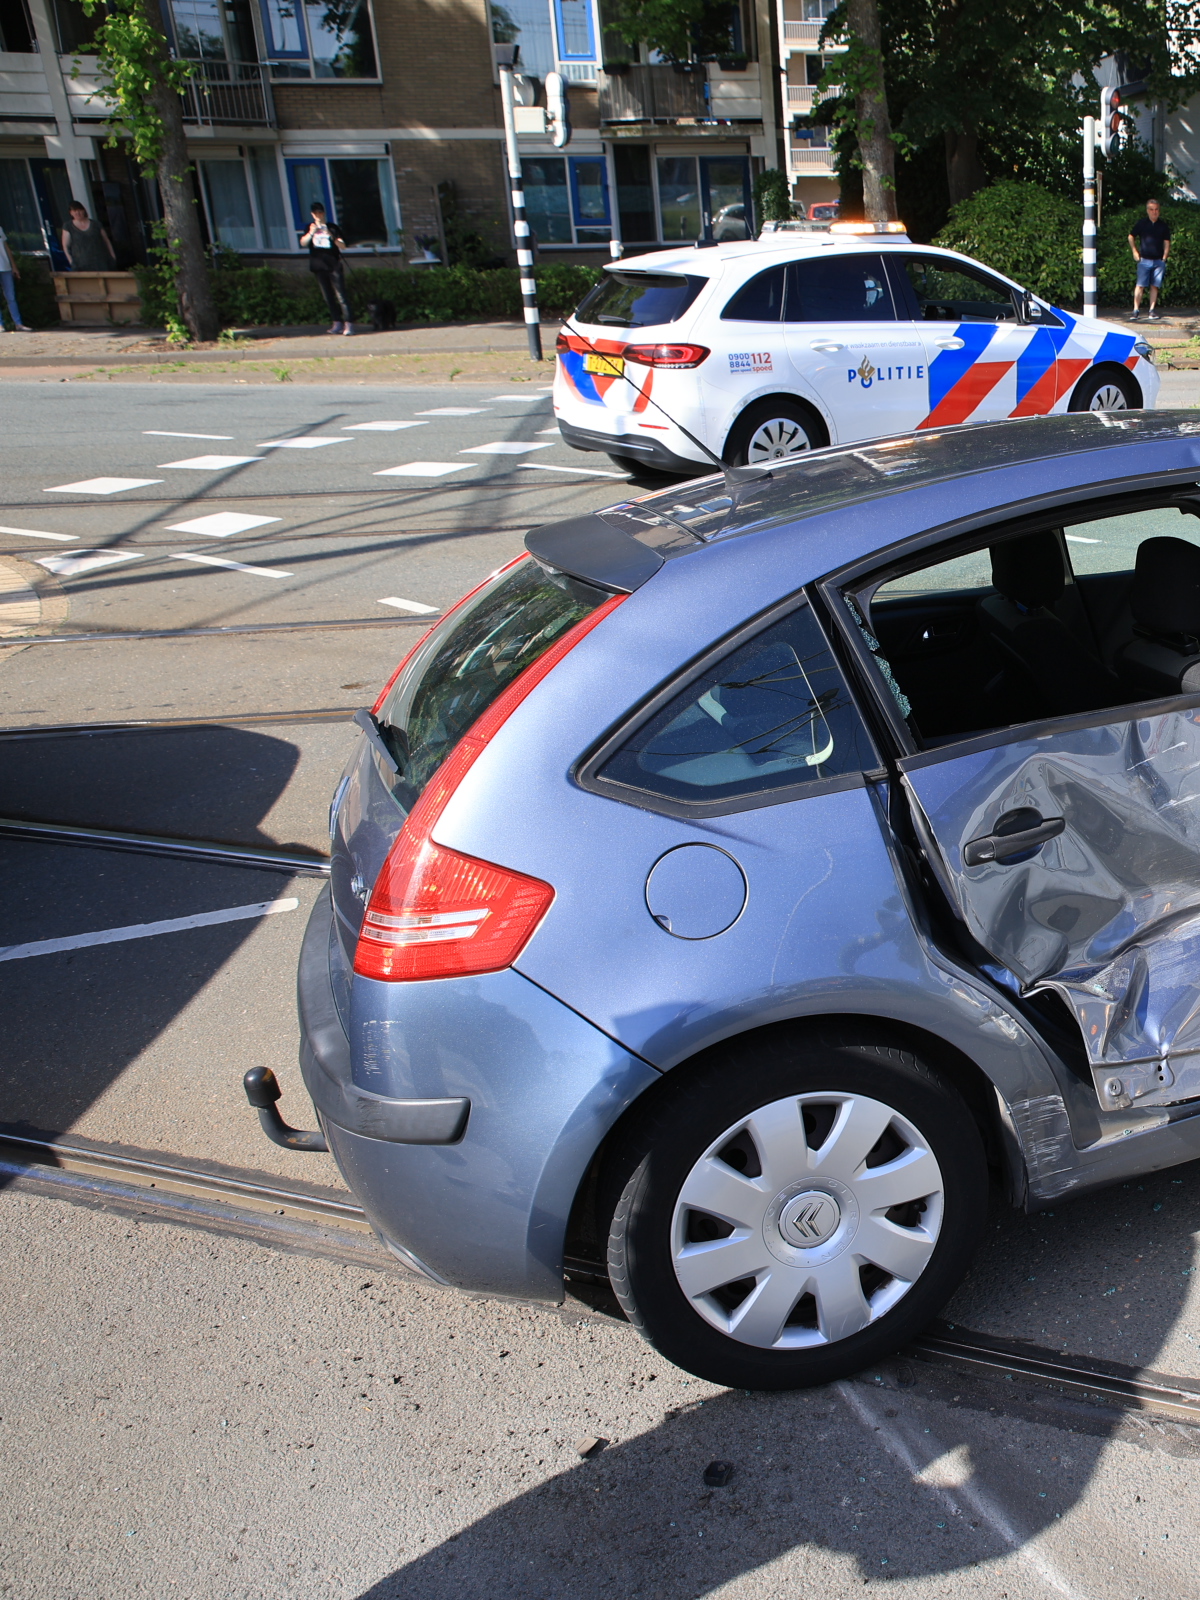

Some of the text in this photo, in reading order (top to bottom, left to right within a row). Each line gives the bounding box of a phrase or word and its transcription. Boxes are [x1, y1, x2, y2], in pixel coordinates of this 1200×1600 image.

[728, 352, 750, 361] 0900
[751, 352, 771, 365] 112
[729, 360, 751, 368] 8844
[752, 364, 773, 373] spoed
[847, 365, 924, 389] POLITIE
